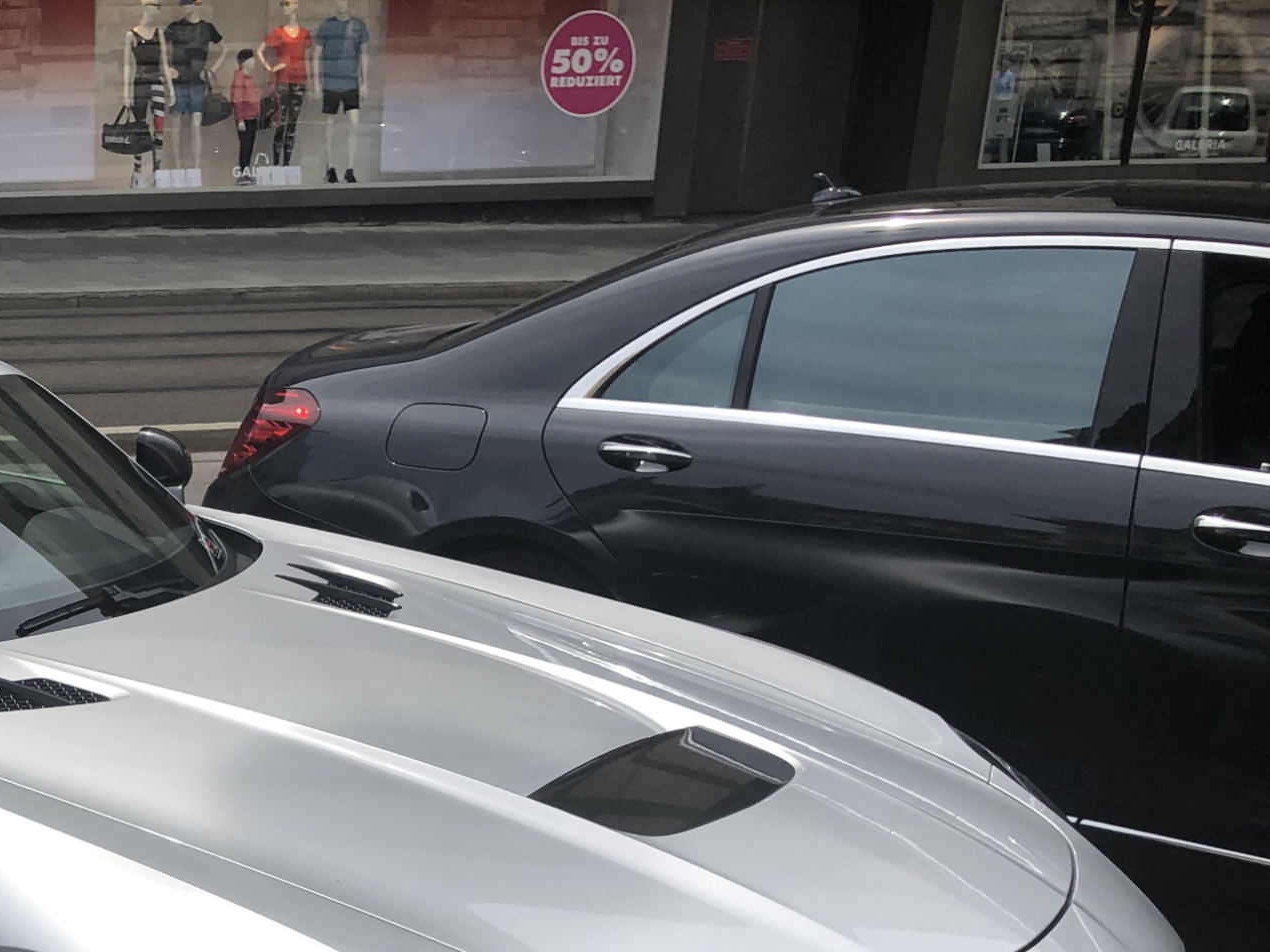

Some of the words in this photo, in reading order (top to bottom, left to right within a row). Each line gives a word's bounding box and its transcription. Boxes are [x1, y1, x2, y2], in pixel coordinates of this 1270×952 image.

[570, 36, 589, 46] BIS
[592, 35, 609, 46] ZU
[550, 47, 625, 74] 50%
[550, 75, 623, 88] REDUZIERT
